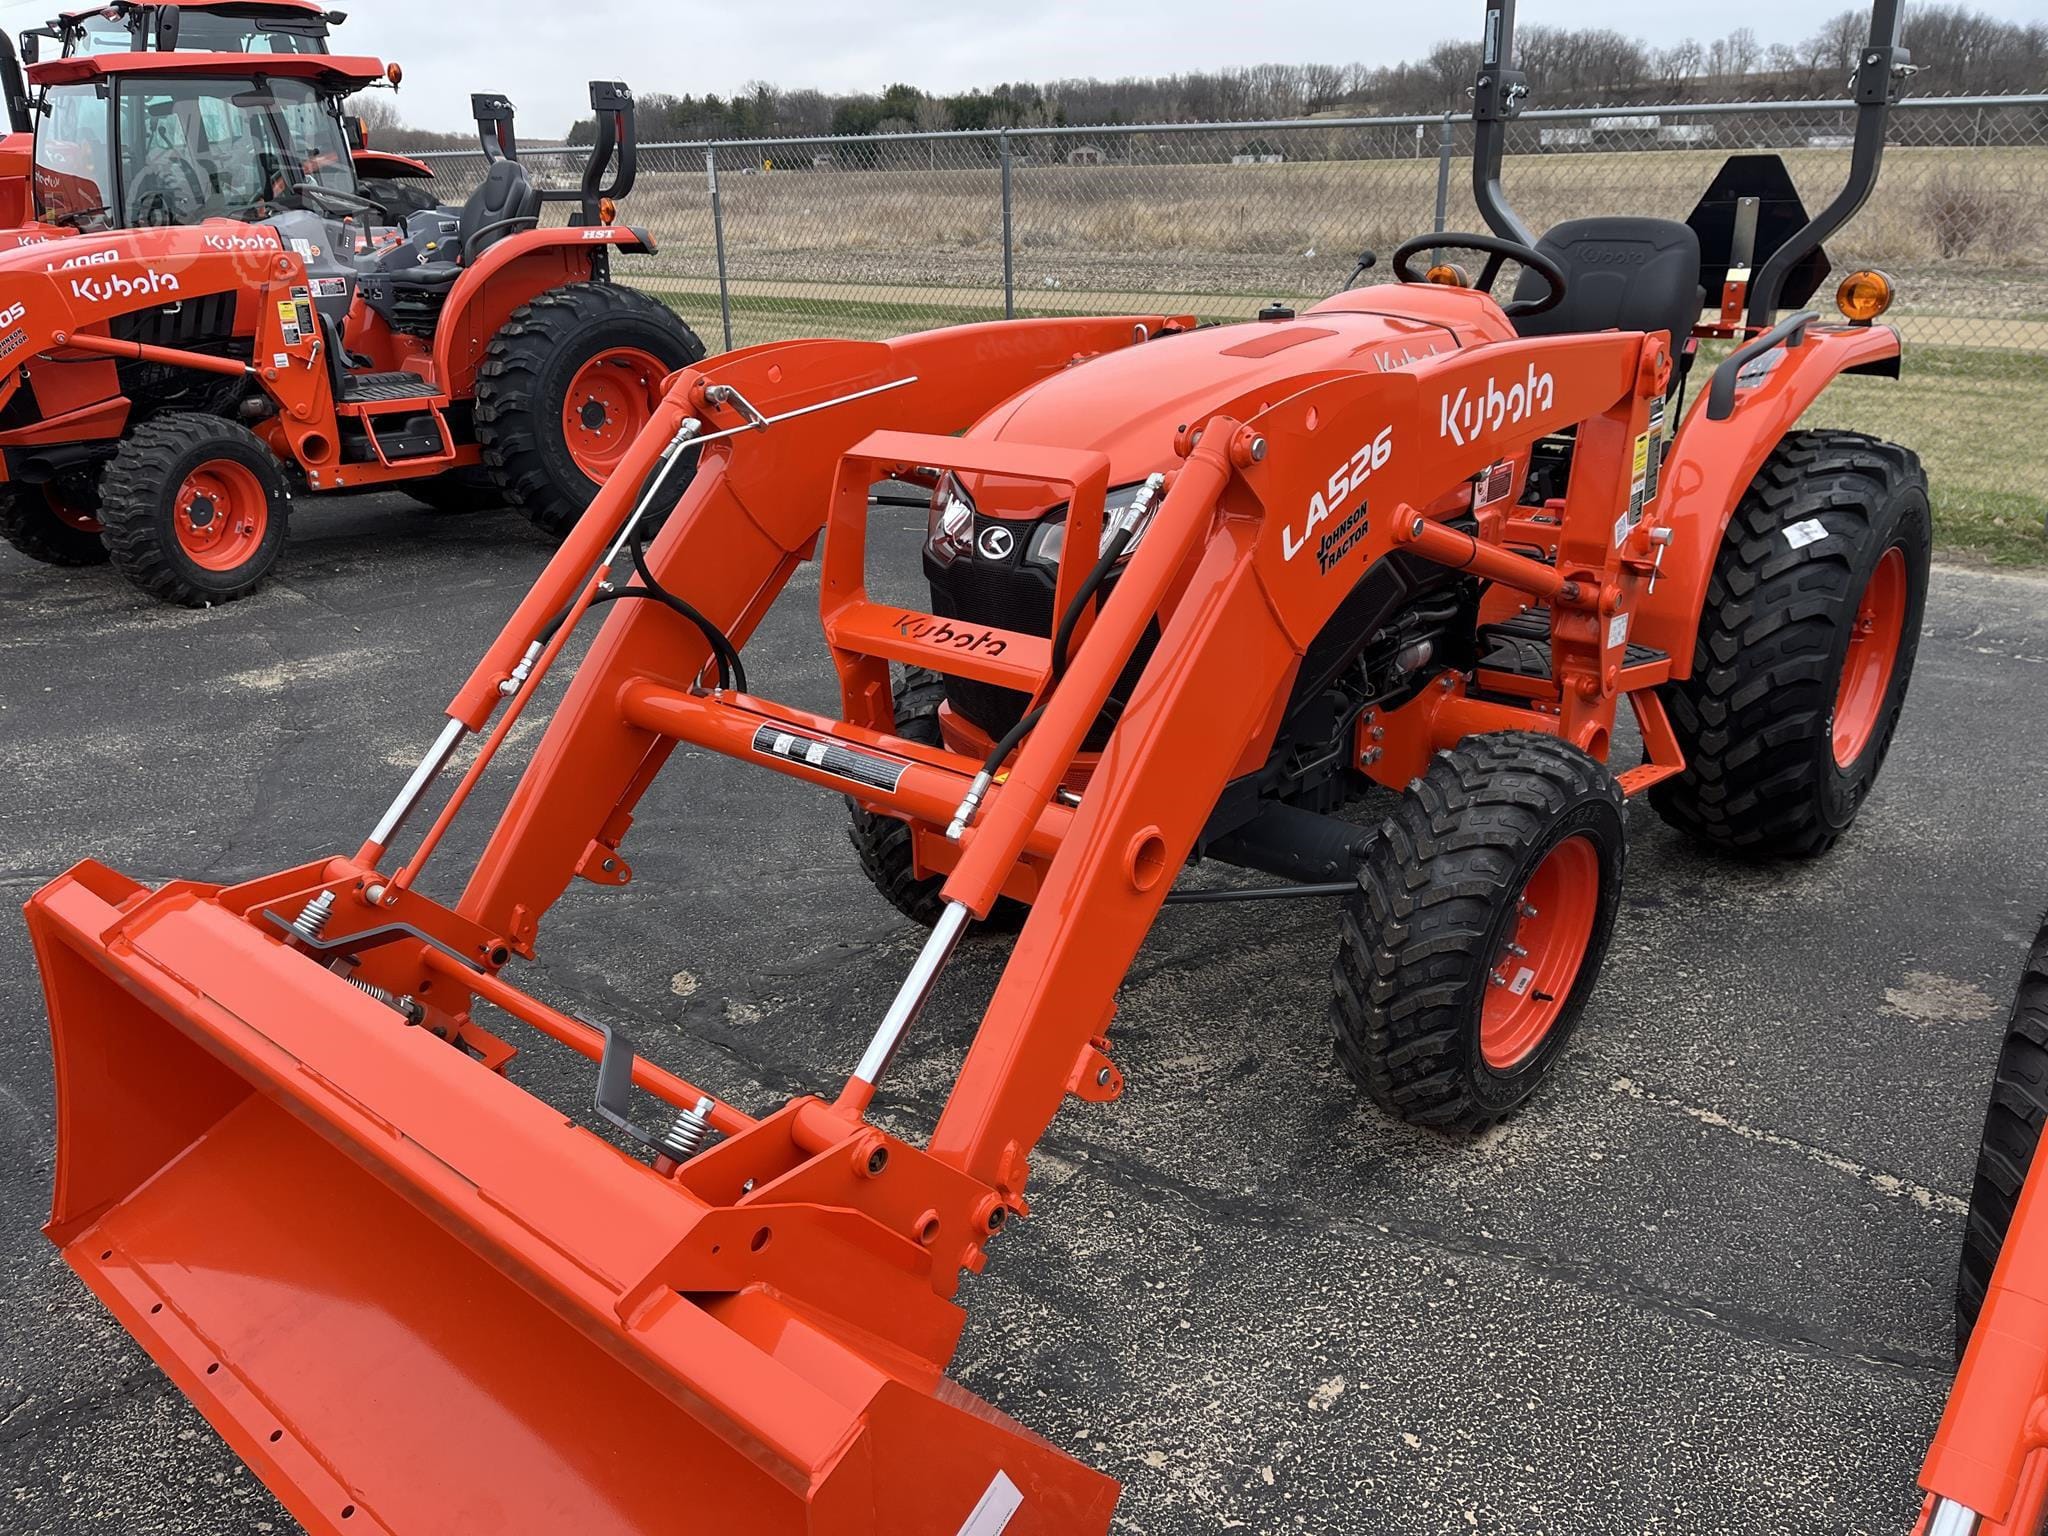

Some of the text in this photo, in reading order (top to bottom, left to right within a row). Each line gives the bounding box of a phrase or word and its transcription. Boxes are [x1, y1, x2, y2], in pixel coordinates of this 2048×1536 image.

[205, 234, 279, 250] Kubota
[582, 230, 615, 239] HST
[47, 249, 119, 272] L4060
[71, 269, 180, 302] Kubota
[1440, 362, 1554, 447] Kubota
[1282, 425, 1393, 561] LA526
[1316, 500, 1369, 559] JOHNSON
[1318, 520, 1369, 576] TRACTOR
[892, 614, 1007, 657] Kubota
